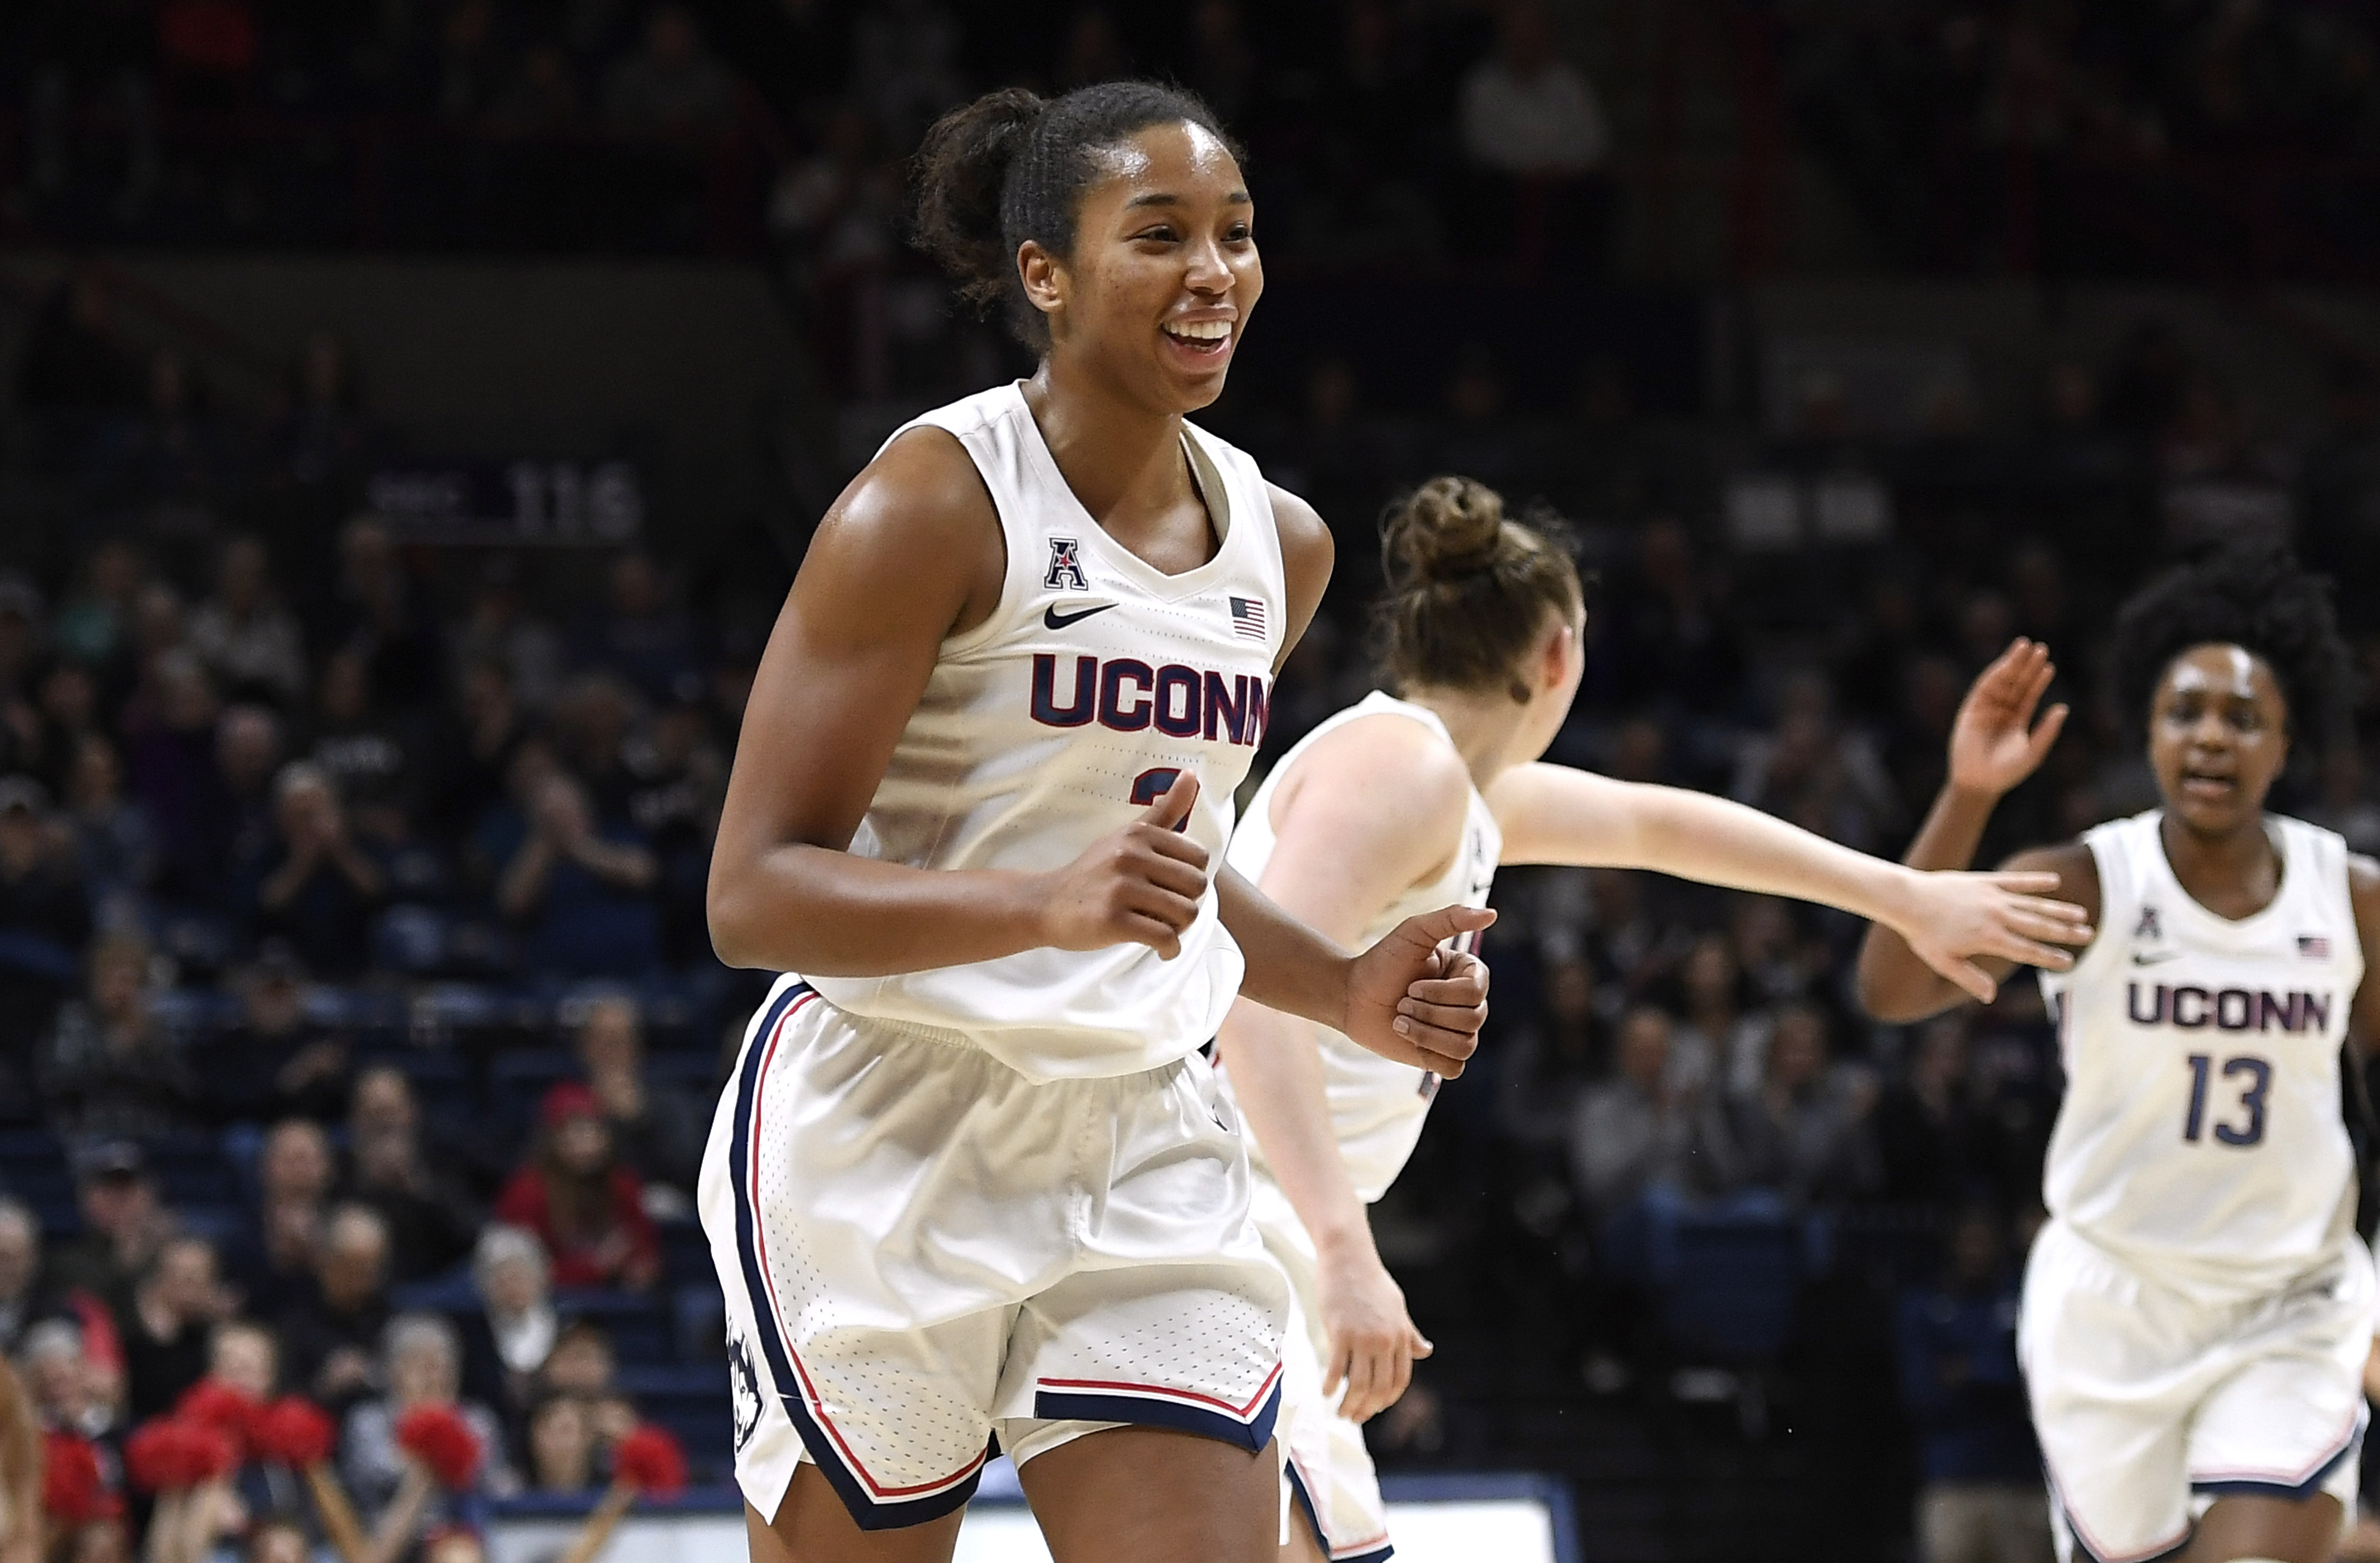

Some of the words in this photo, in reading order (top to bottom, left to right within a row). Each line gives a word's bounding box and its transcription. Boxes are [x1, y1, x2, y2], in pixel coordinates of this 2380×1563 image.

[1044, 537, 1089, 591] A
[2129, 983, 2330, 1034] UCONN
[2185, 1055, 2271, 1146] 13
